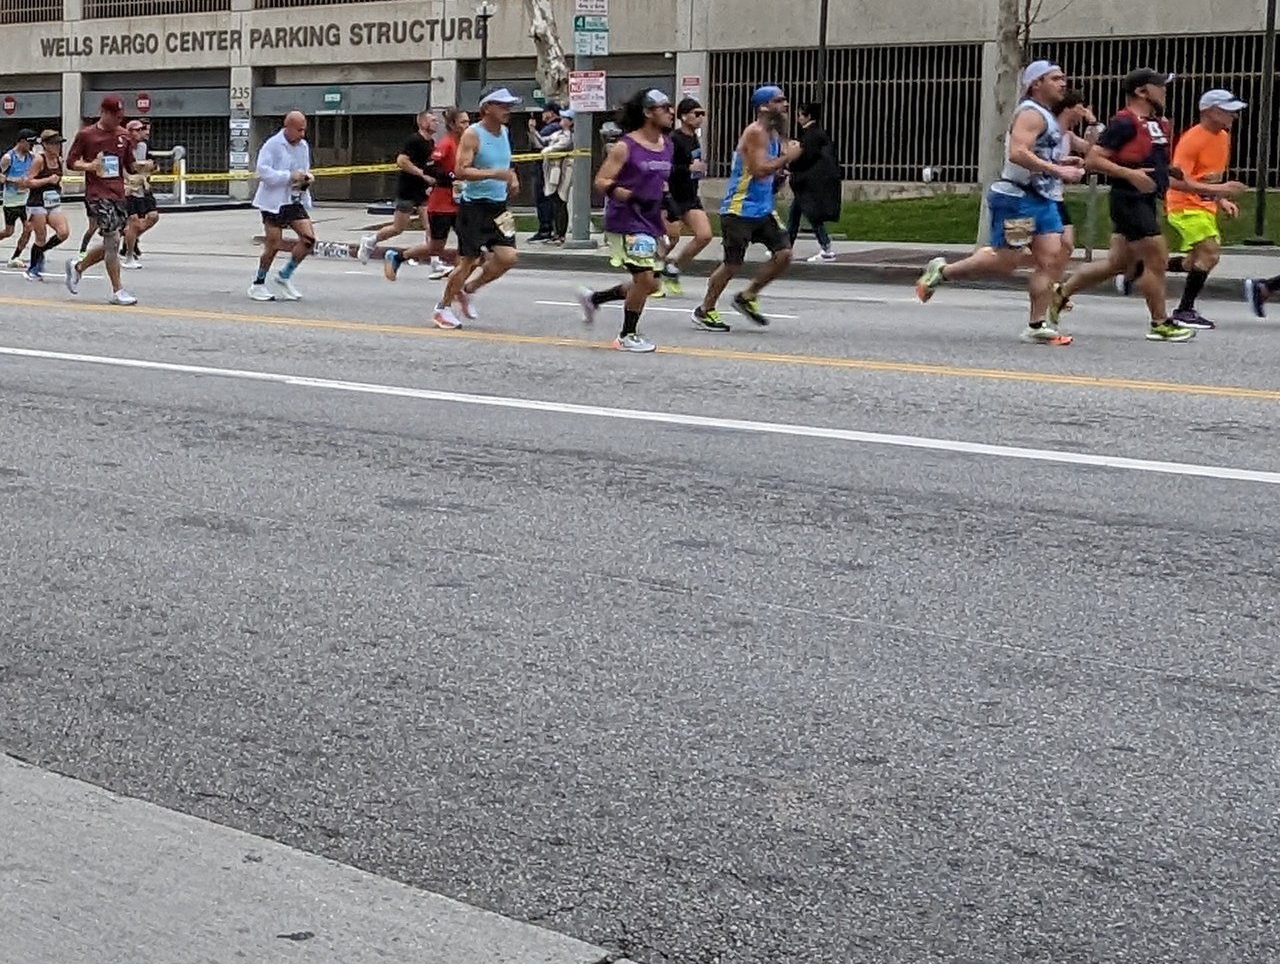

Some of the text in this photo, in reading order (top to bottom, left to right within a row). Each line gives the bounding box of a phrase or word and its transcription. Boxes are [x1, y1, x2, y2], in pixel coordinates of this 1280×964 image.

[40, 17, 488, 57] WELLS FARGO CENTER PARKING STRUCTURE
[231, 87, 250, 100] 235
